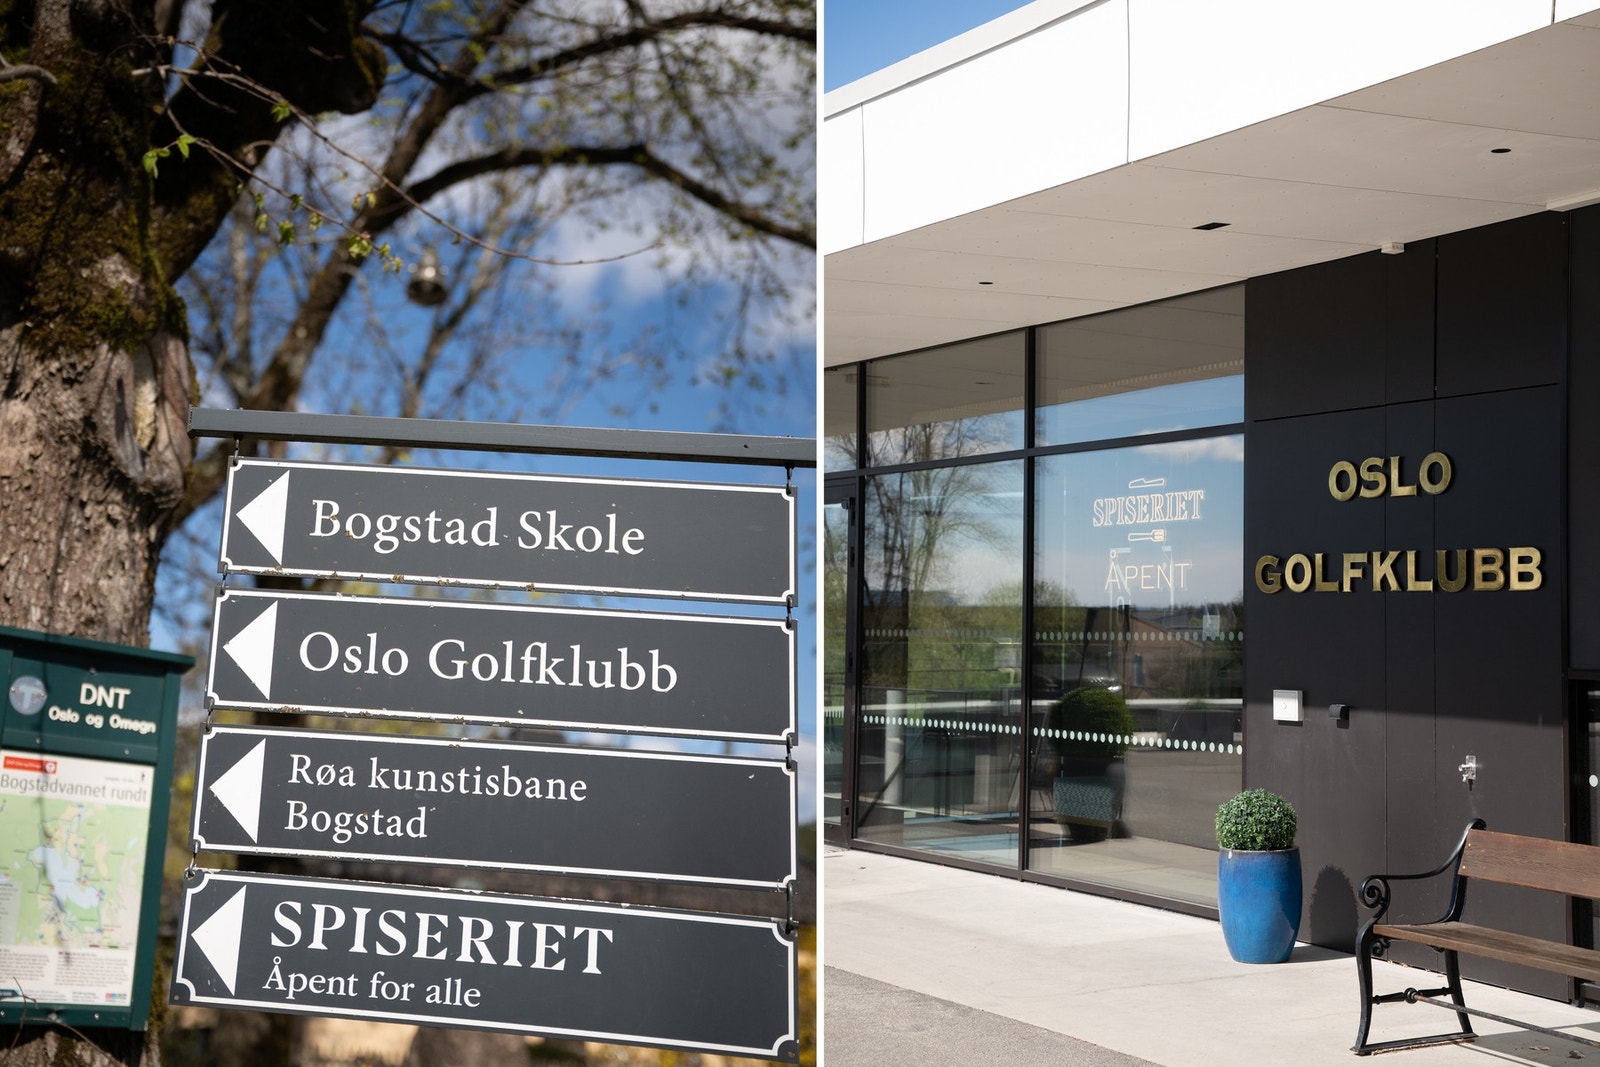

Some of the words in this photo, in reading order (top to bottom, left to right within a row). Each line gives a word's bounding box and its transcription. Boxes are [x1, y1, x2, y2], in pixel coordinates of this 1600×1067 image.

[1328, 451, 1452, 501] OSLO
[309, 499, 500, 554] Bogstad
[517, 509, 646, 556] Skole
[1092, 489, 1204, 527] SPISERIET
[1104, 549, 1190, 590] ÅPENT
[1255, 546, 1543, 594] GOLFKLUBB
[299, 631, 409, 676] Oslo
[428, 638, 678, 693] Golfklubb
[48, 706, 80, 723] Oslo
[85, 714, 104, 728] og
[109, 714, 156, 734] Omegn
[79, 683, 131, 709] DNT
[0, 774, 107, 799] Bogstadvannet
[110, 787, 147, 803] rundt
[287, 753, 356, 788] Røa
[368, 757, 588, 802] kunstisbane
[284, 799, 428, 844] Bogstad
[270, 900, 614, 975] SPISERIET
[262, 956, 358, 1000] Åpent
[369, 970, 415, 1001] for
[425, 977, 482, 1008] alle
